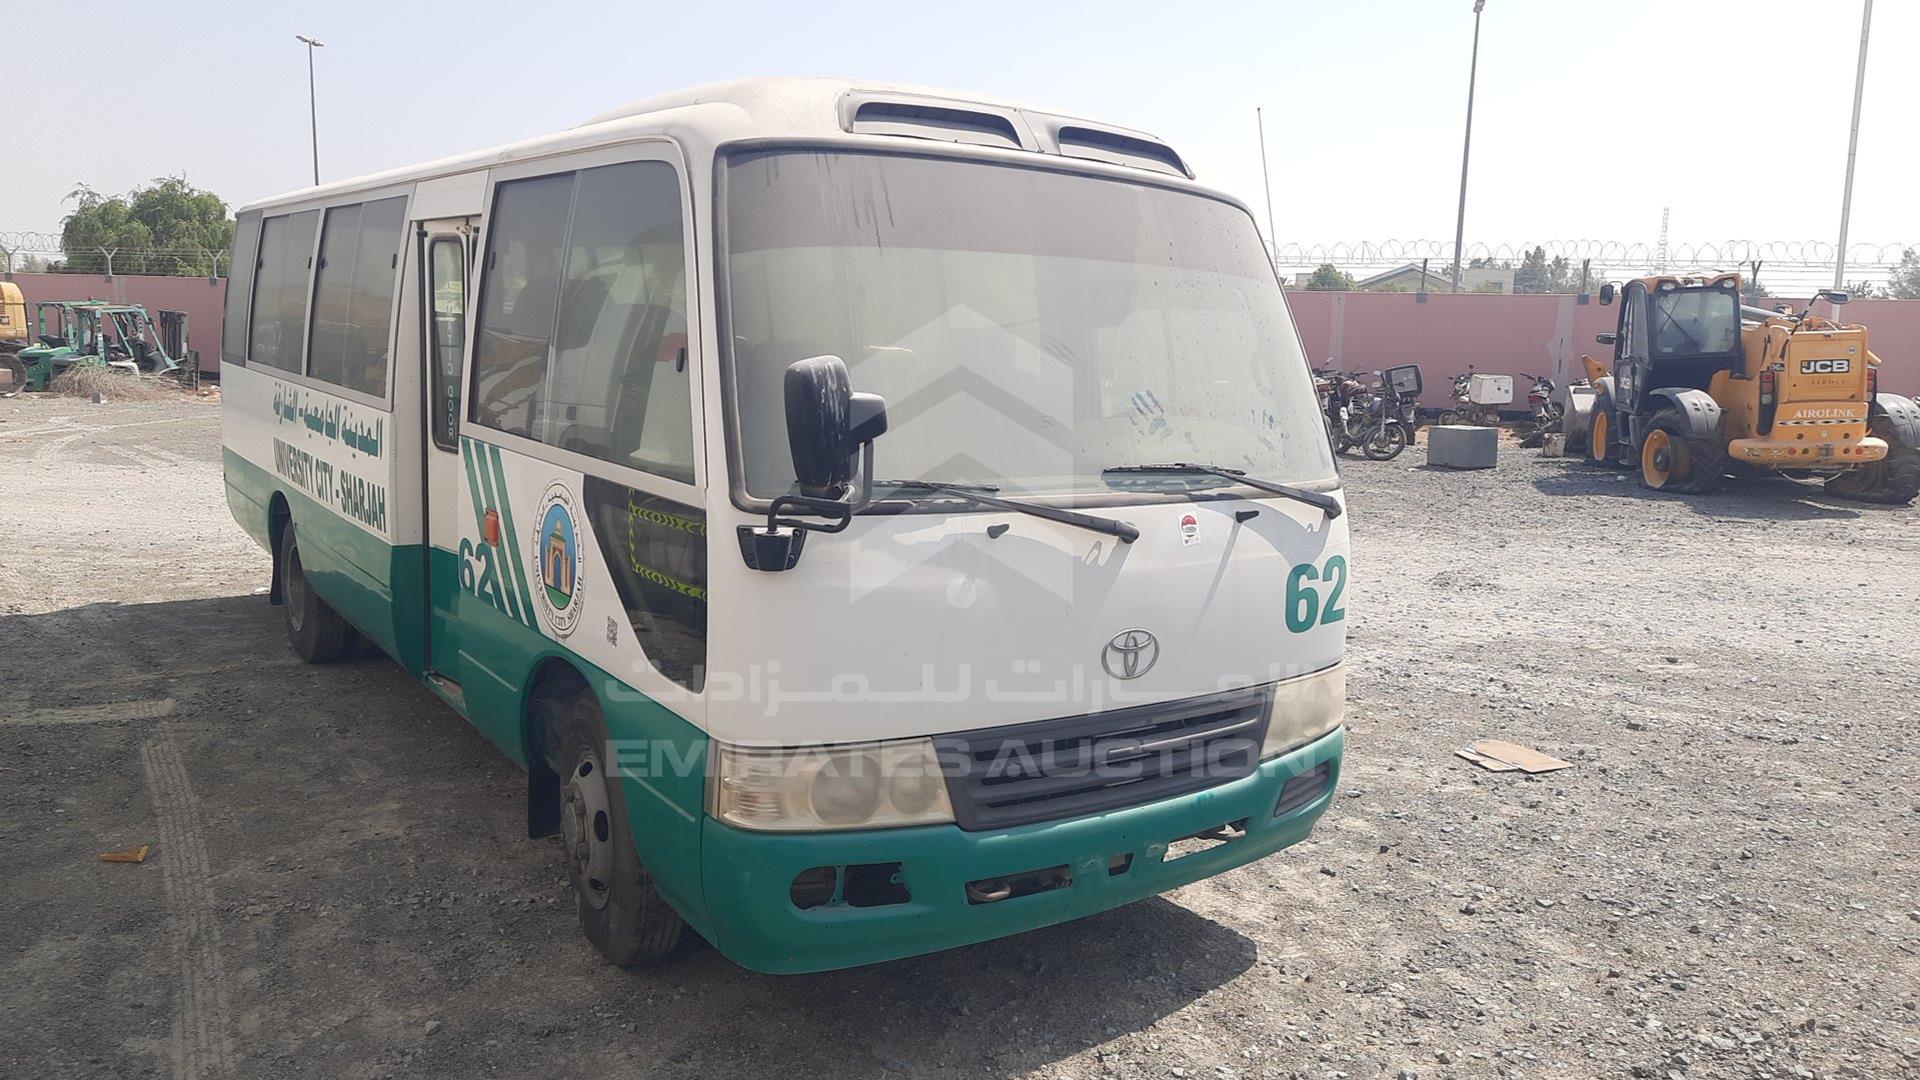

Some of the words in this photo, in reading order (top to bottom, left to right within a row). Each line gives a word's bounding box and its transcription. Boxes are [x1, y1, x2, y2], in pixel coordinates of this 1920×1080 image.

[1801, 360, 1849, 373] JCB
[1794, 408, 1856, 418] AIROLINK
[273, 436, 314, 494] UNIVERSITY
[314, 458, 334, 506] CITY
[340, 469, 387, 534] SHARJAH
[459, 537, 494, 608] 62
[1285, 554, 1347, 634] 62
